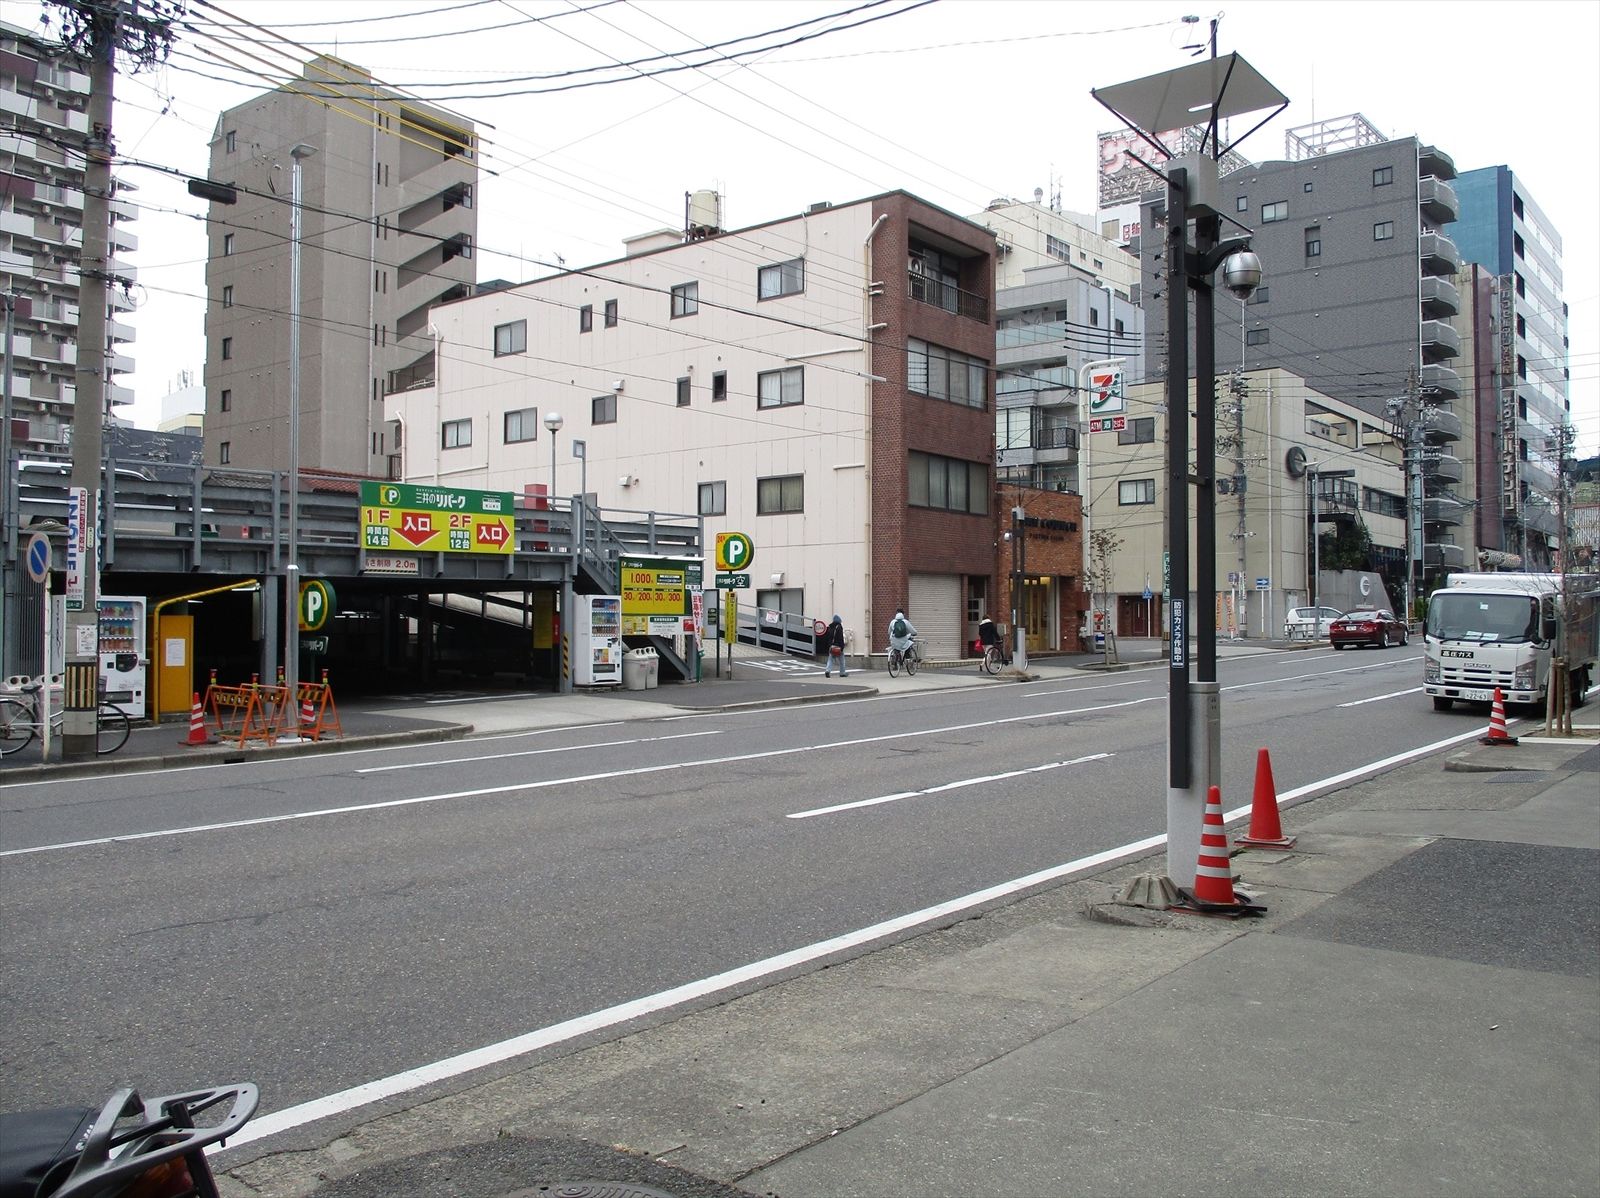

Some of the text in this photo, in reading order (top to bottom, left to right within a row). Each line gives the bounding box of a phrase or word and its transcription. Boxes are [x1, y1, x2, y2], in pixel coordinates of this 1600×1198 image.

[388, 489, 398, 502] P
[415, 492, 466, 509] 三井のリパーク
[403, 516, 431, 532] 入口
[449, 513, 472, 529] 2F
[366, 526, 389, 535] 時間貸
[450, 530, 470, 539] 時間貸
[478, 526, 503, 541] 入口
[366, 535, 389, 546] 14台
[450, 539, 470, 549] 12台
[729, 540, 744, 564] P
[395, 560, 416, 569] 2.0m
[308, 591, 322, 621] P
[1173, 601, 1182, 662] 防犯カメラ作動中
[1442, 650, 1472, 658] 高圧ガス
